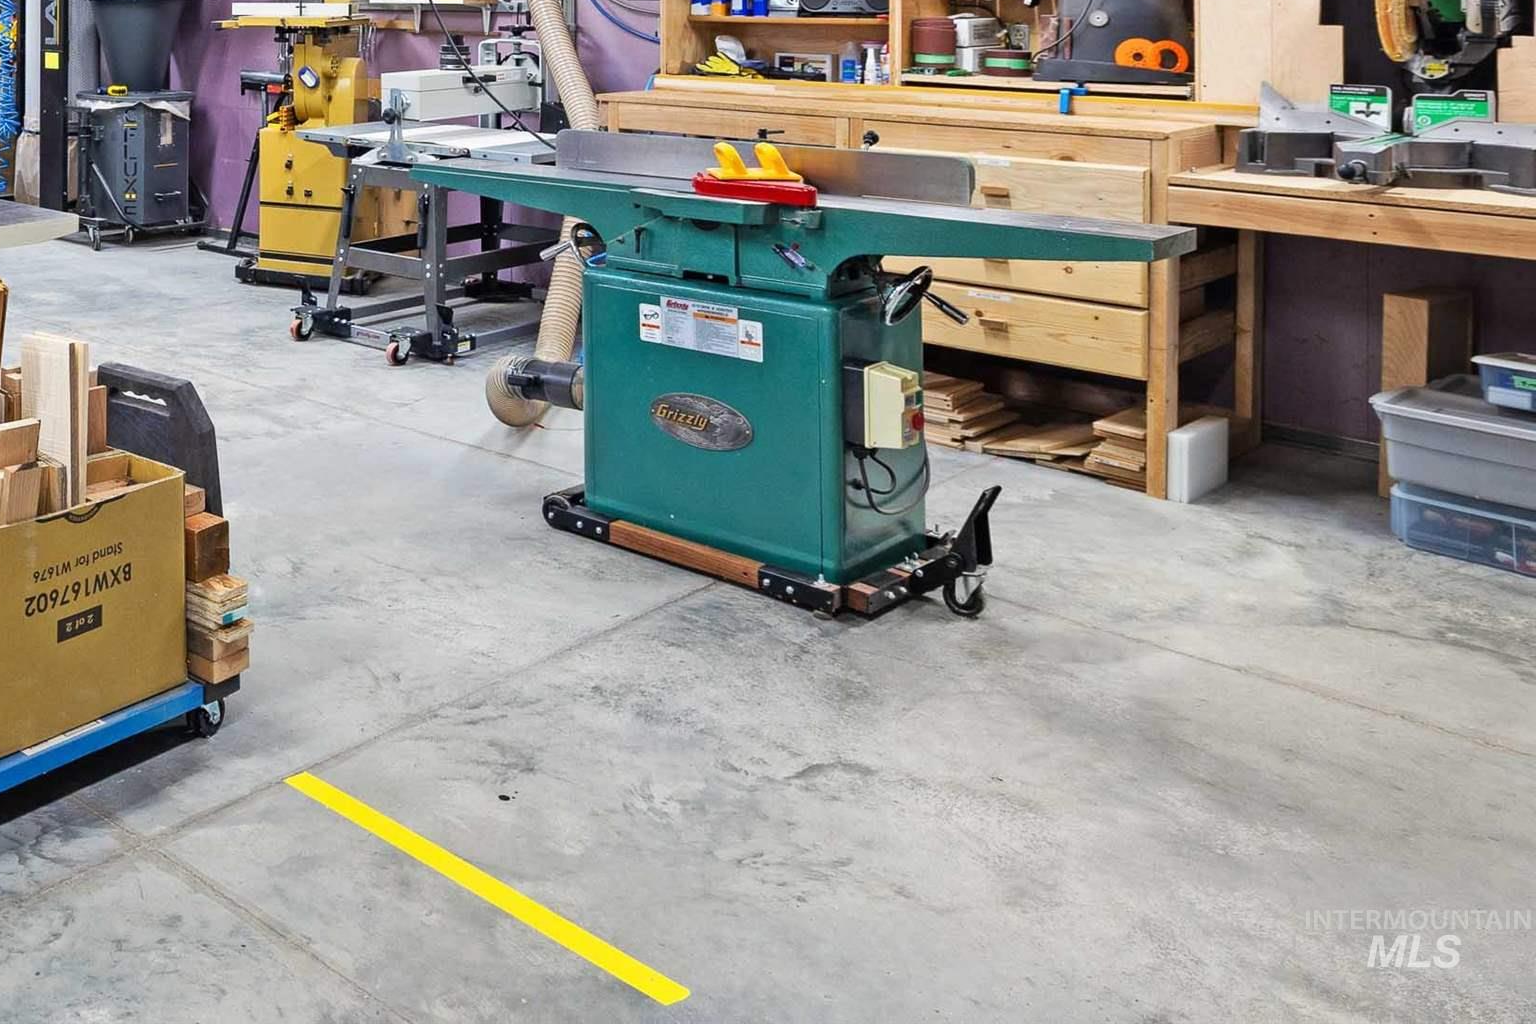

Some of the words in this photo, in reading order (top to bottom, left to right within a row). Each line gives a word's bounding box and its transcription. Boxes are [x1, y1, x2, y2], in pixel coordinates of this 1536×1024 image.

[656, 403, 709, 431] Grizzly
[74, 554, 90, 568] for
[92, 542, 124, 564] Stand
[32, 561, 72, 584] W1676
[24, 562, 132, 617] BXW167602
[66, 622, 73, 632] 2
[75, 617, 85, 630] of
[87, 613, 95, 624] 2
